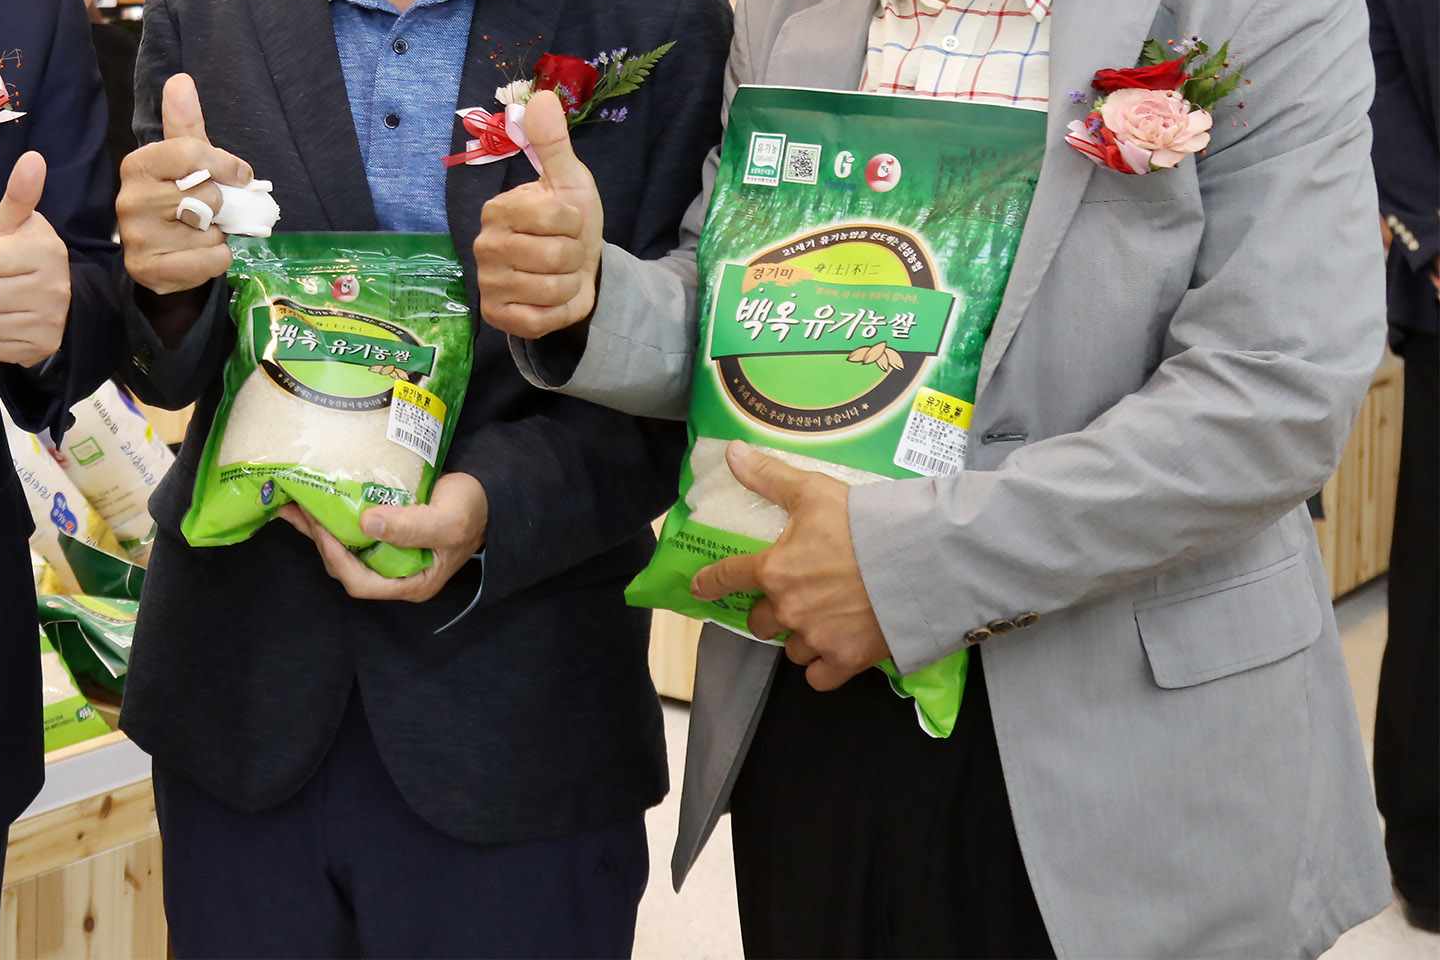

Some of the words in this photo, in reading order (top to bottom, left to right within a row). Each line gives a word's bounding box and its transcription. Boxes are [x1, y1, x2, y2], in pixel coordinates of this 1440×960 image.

[782, 239, 816, 257] 21세기
[820, 230, 868, 245] 유기농업을
[870, 230, 900, 247] 선도하는
[897, 242, 924, 273] 원삼농협
[752, 266, 795, 281] 경기미
[735, 287, 800, 343] 백옥
[769, 410, 785, 423] 우리
